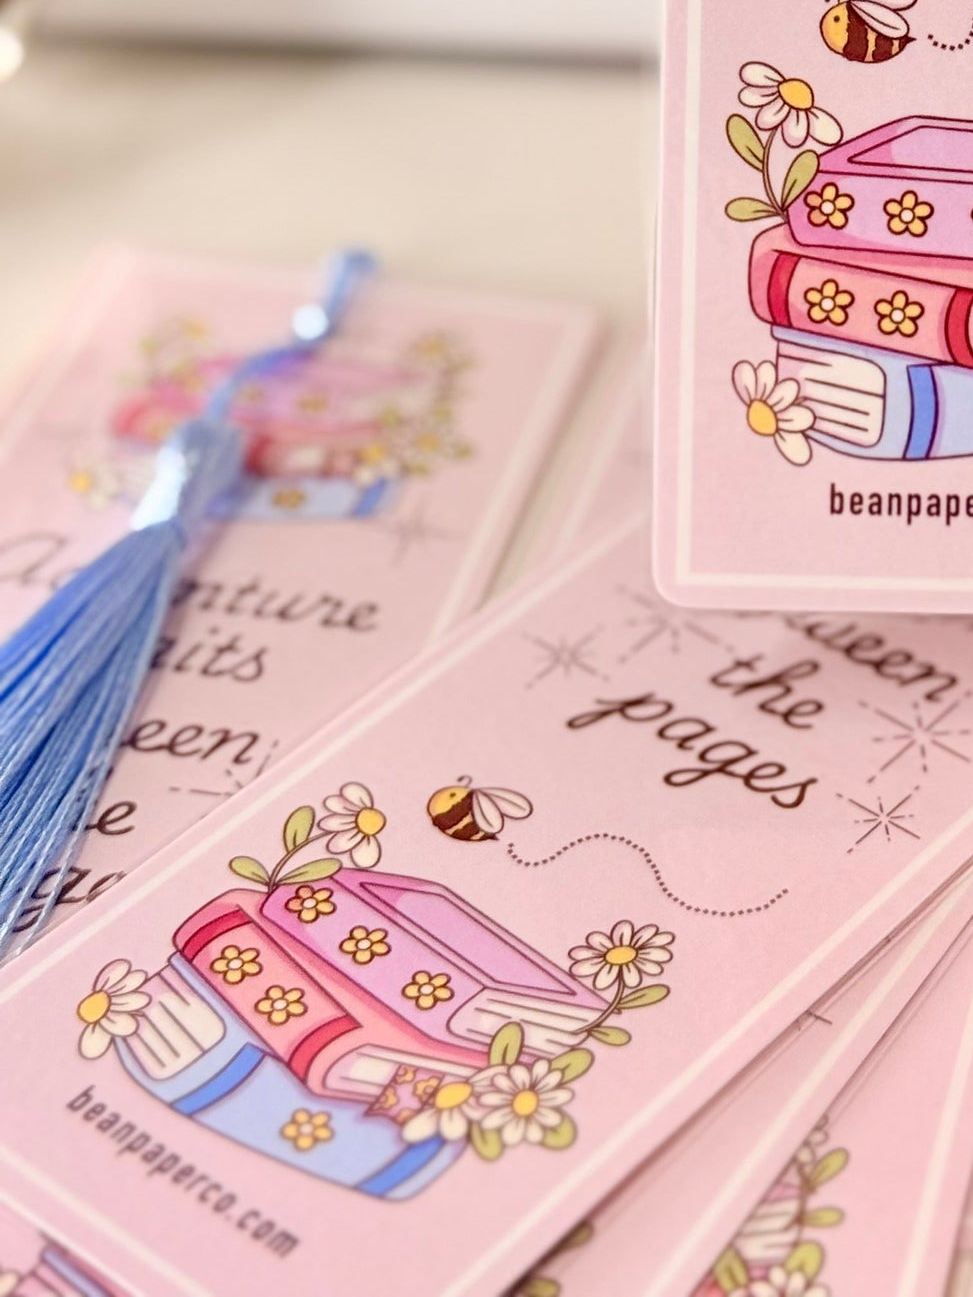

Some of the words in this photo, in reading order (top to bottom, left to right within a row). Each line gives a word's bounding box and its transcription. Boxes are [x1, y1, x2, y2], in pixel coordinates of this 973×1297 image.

[0, 529, 380, 633] Anture
[709, 653, 825, 729] the
[783, 612, 959, 701] ween
[566, 692, 818, 809] pages
[66, 1084, 301, 1260] beanpaperco.com
